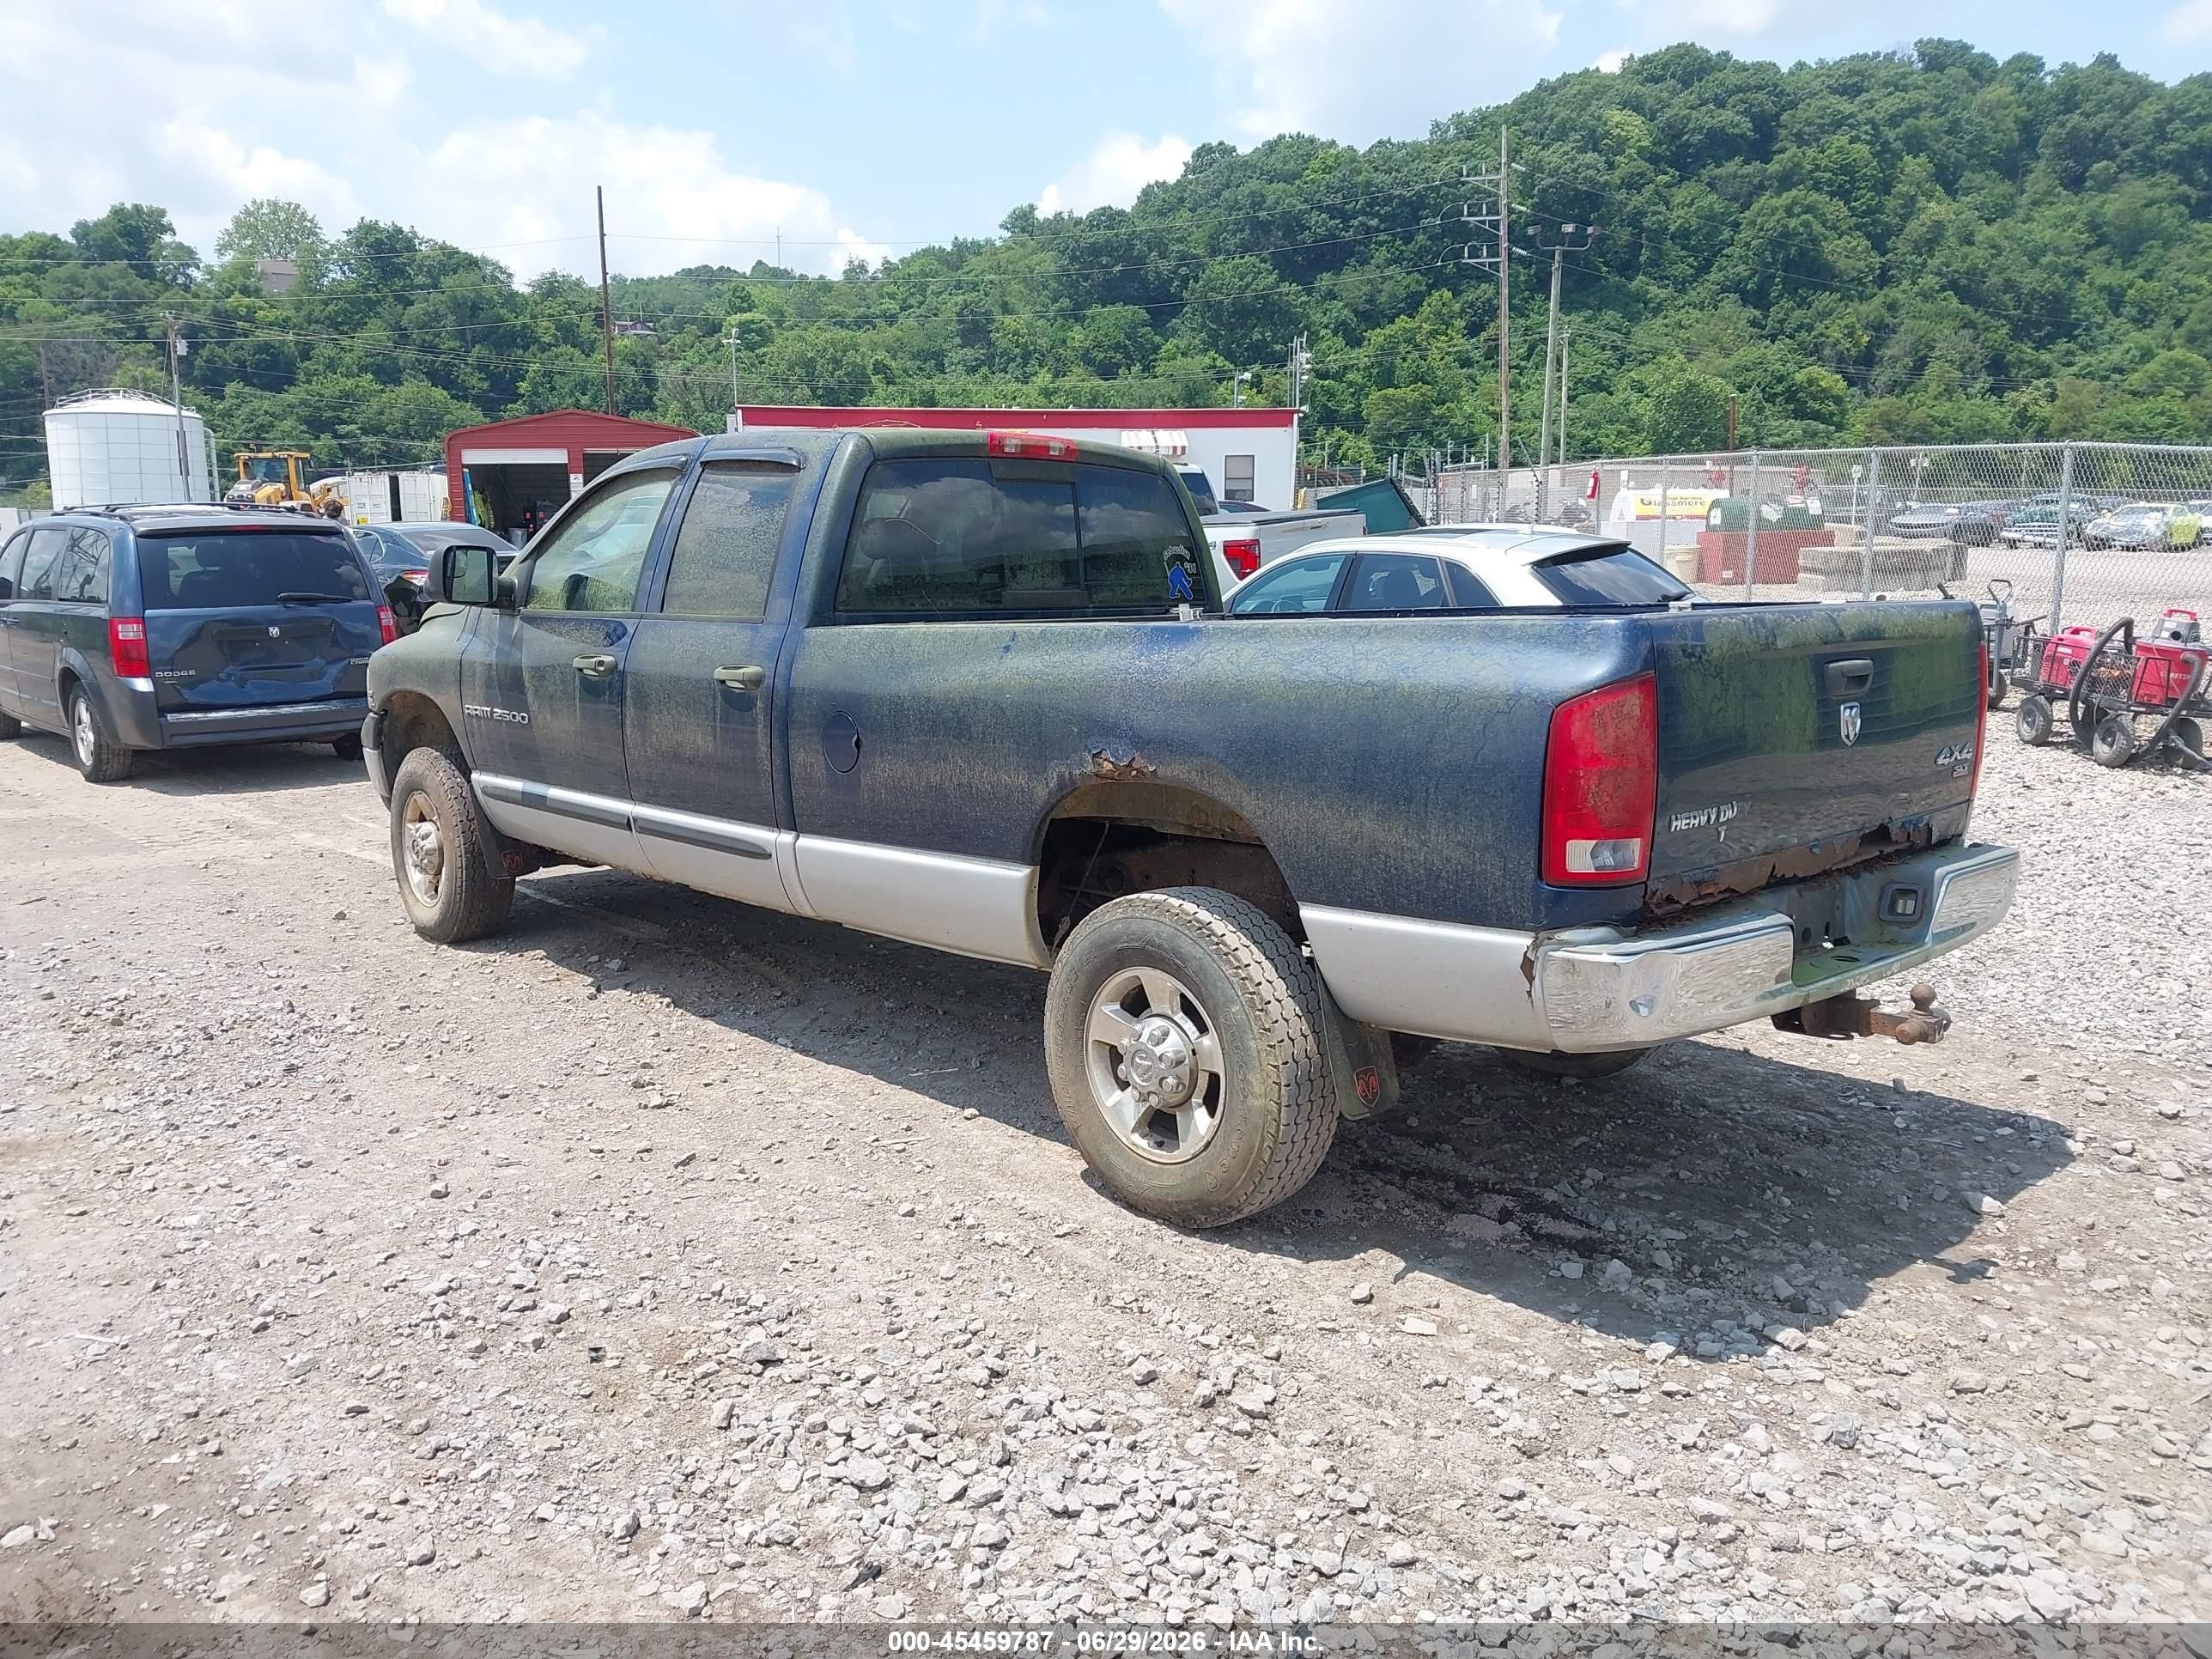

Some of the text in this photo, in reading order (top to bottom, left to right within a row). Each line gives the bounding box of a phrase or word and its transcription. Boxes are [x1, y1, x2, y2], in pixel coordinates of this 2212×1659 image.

[155, 669, 197, 678] DODGE
[465, 704, 529, 725] RAM 2500
[1670, 806, 1718, 832] HEAVY
